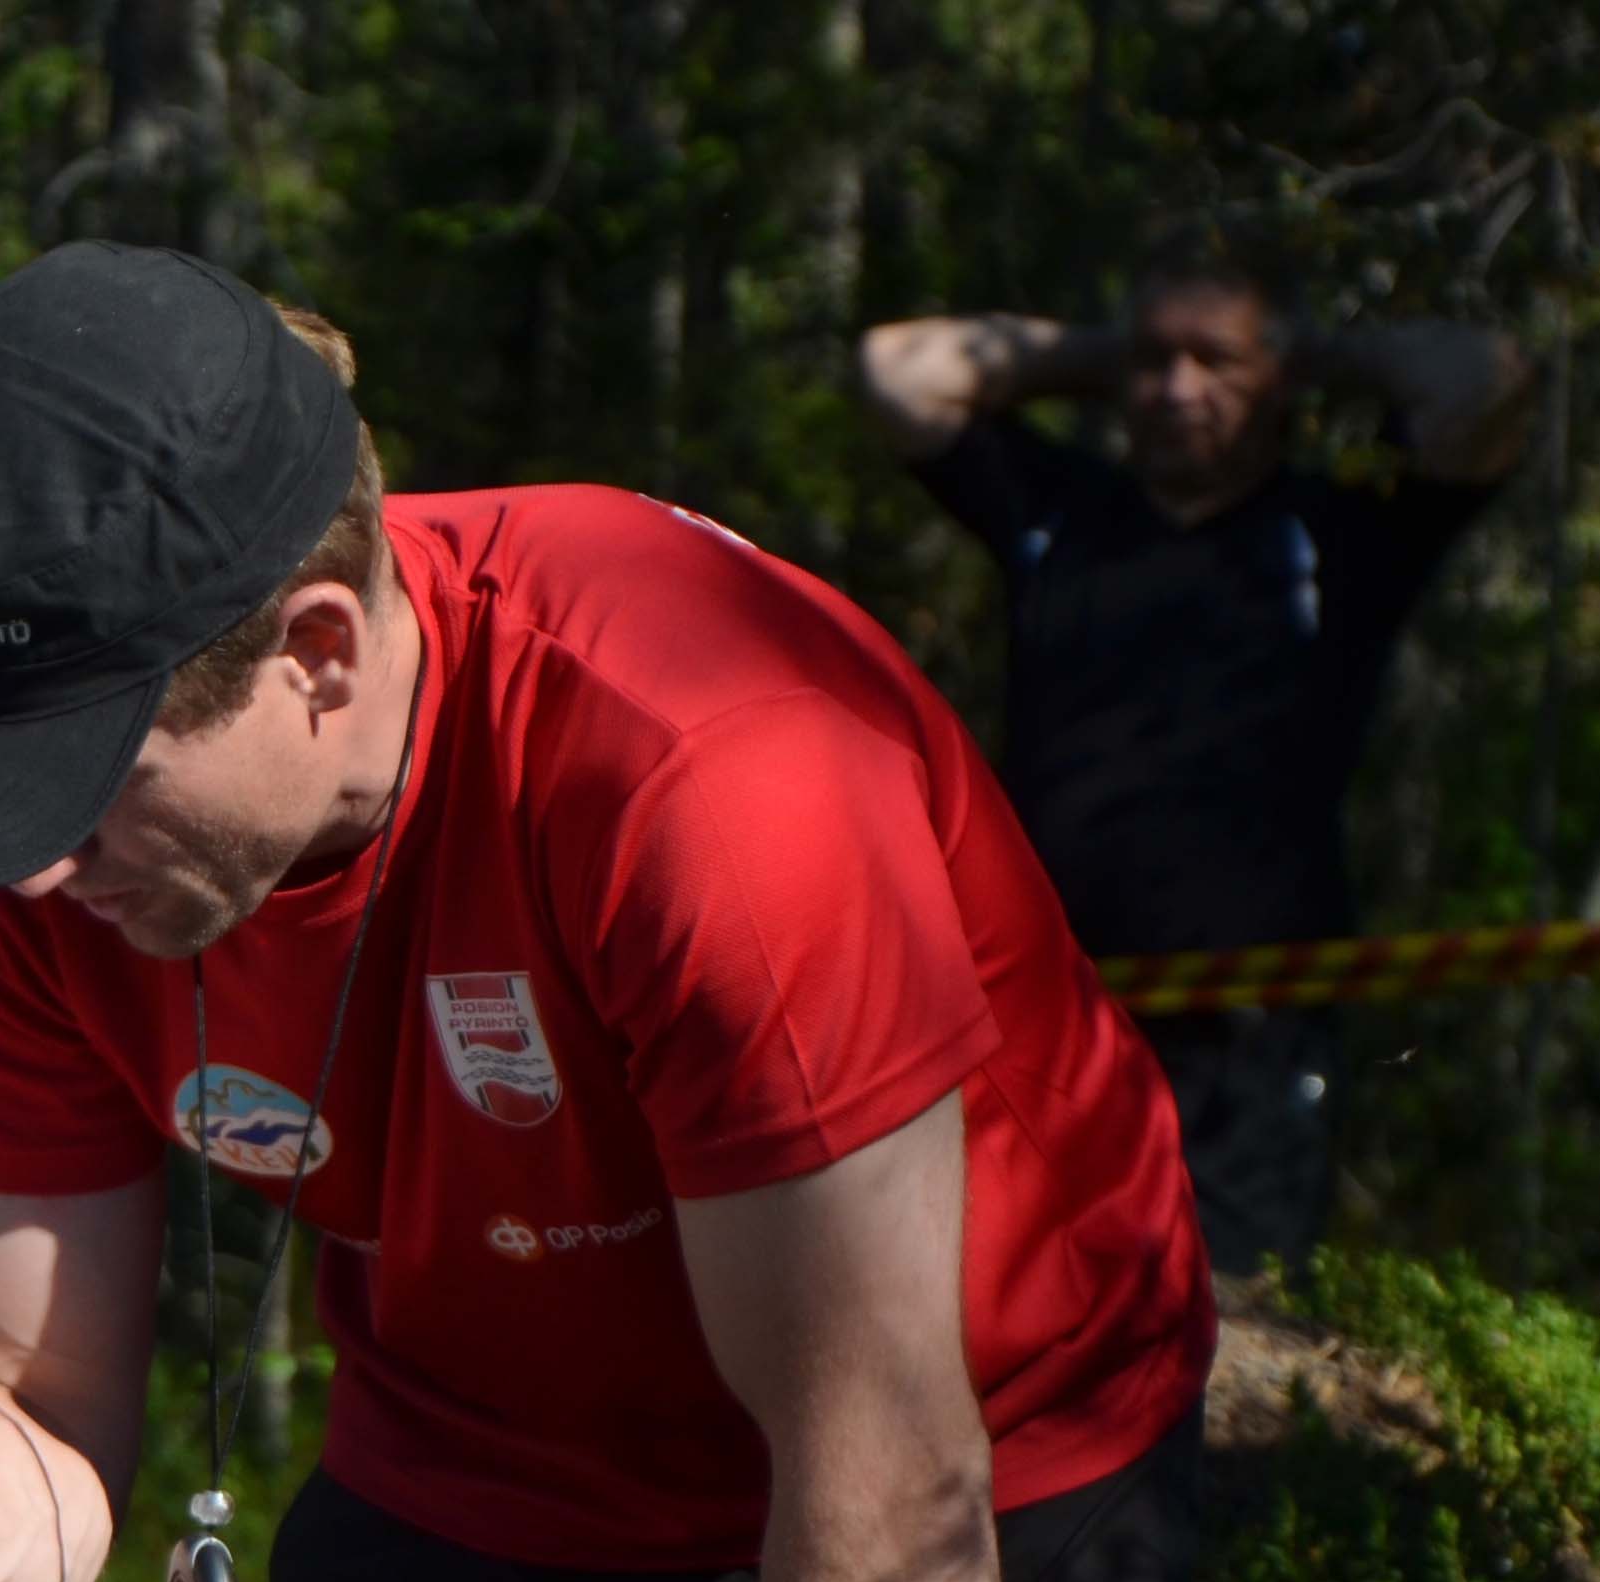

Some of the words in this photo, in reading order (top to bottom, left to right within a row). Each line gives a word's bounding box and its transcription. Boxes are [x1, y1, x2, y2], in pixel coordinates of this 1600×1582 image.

[450, 1002, 520, 1014] POSION
[546, 1226, 583, 1249] OP
[587, 1206, 663, 1245] Posio
